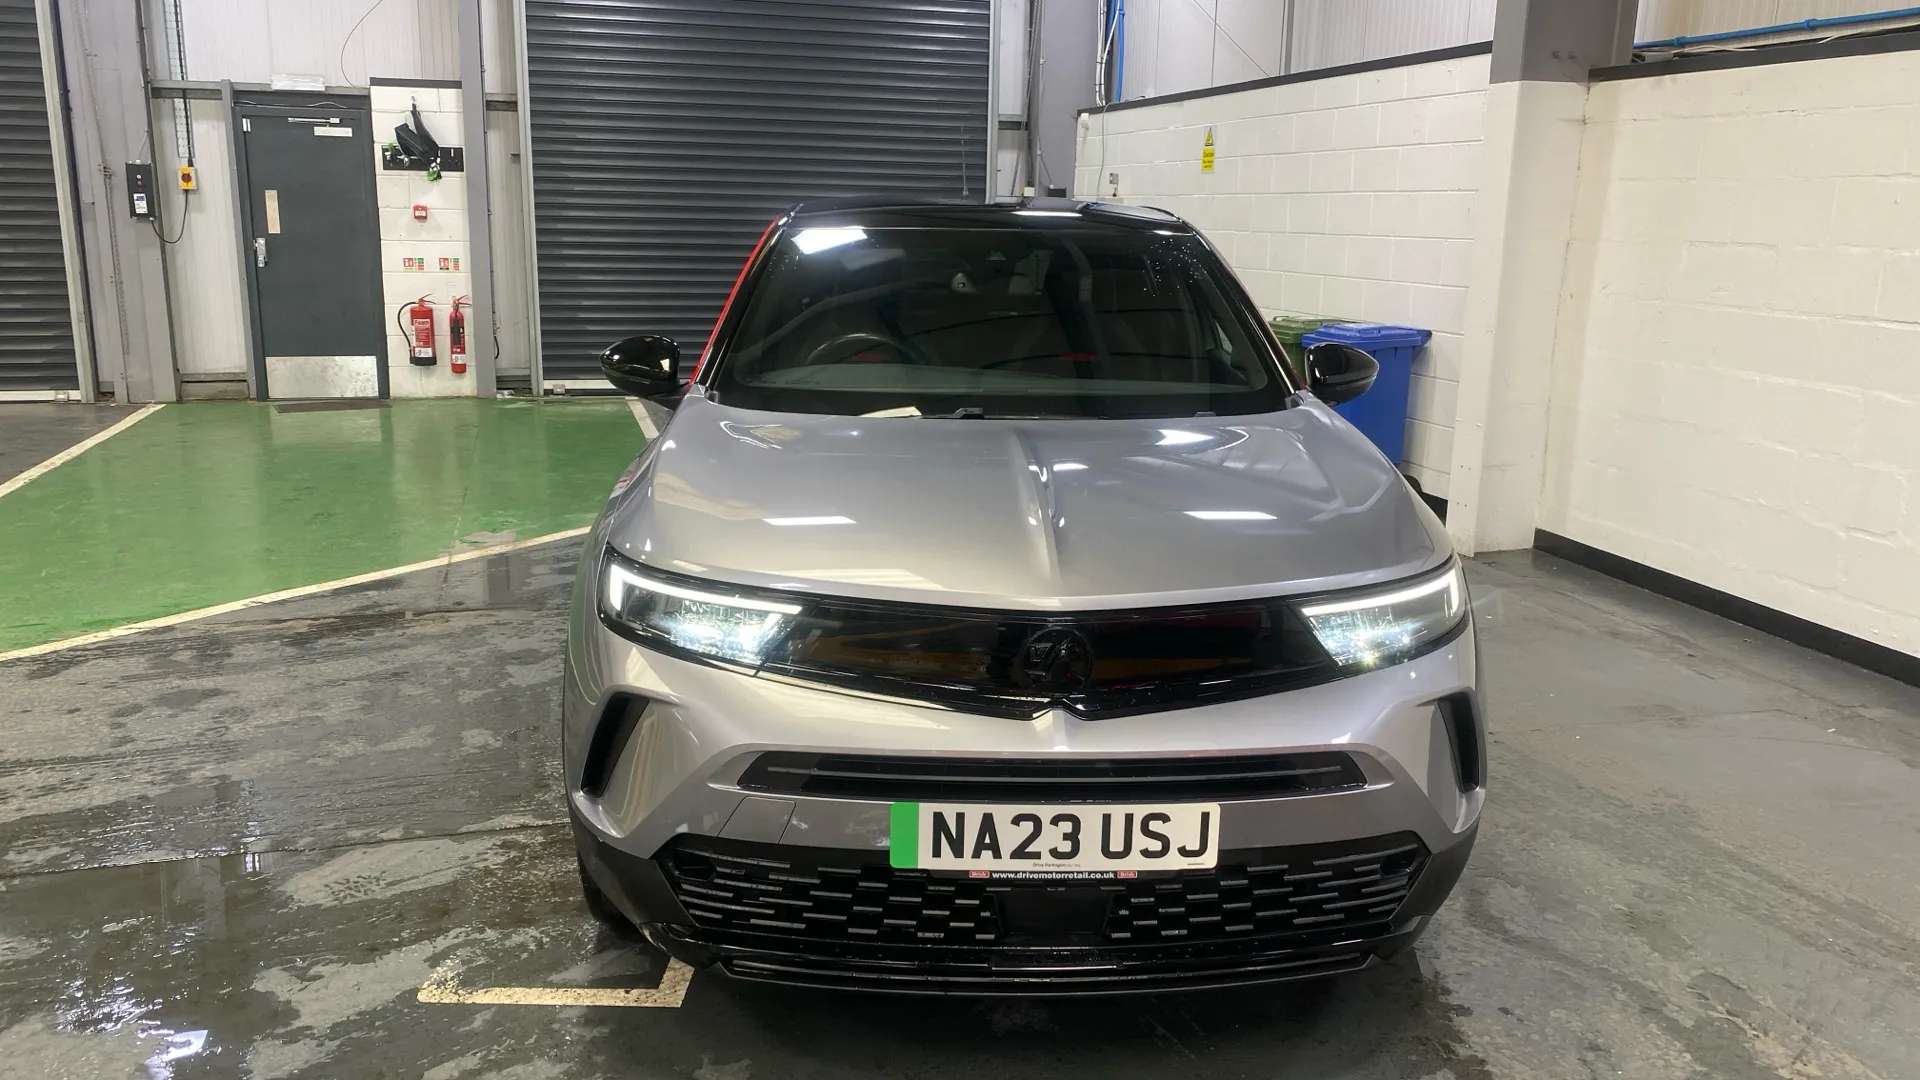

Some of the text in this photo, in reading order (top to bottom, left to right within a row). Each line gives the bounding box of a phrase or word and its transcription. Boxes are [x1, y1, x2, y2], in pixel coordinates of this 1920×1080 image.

[932, 811, 1210, 860] NA23 USJ
[992, 871, 1115, 879] www.drivemotorretail.co.uk
